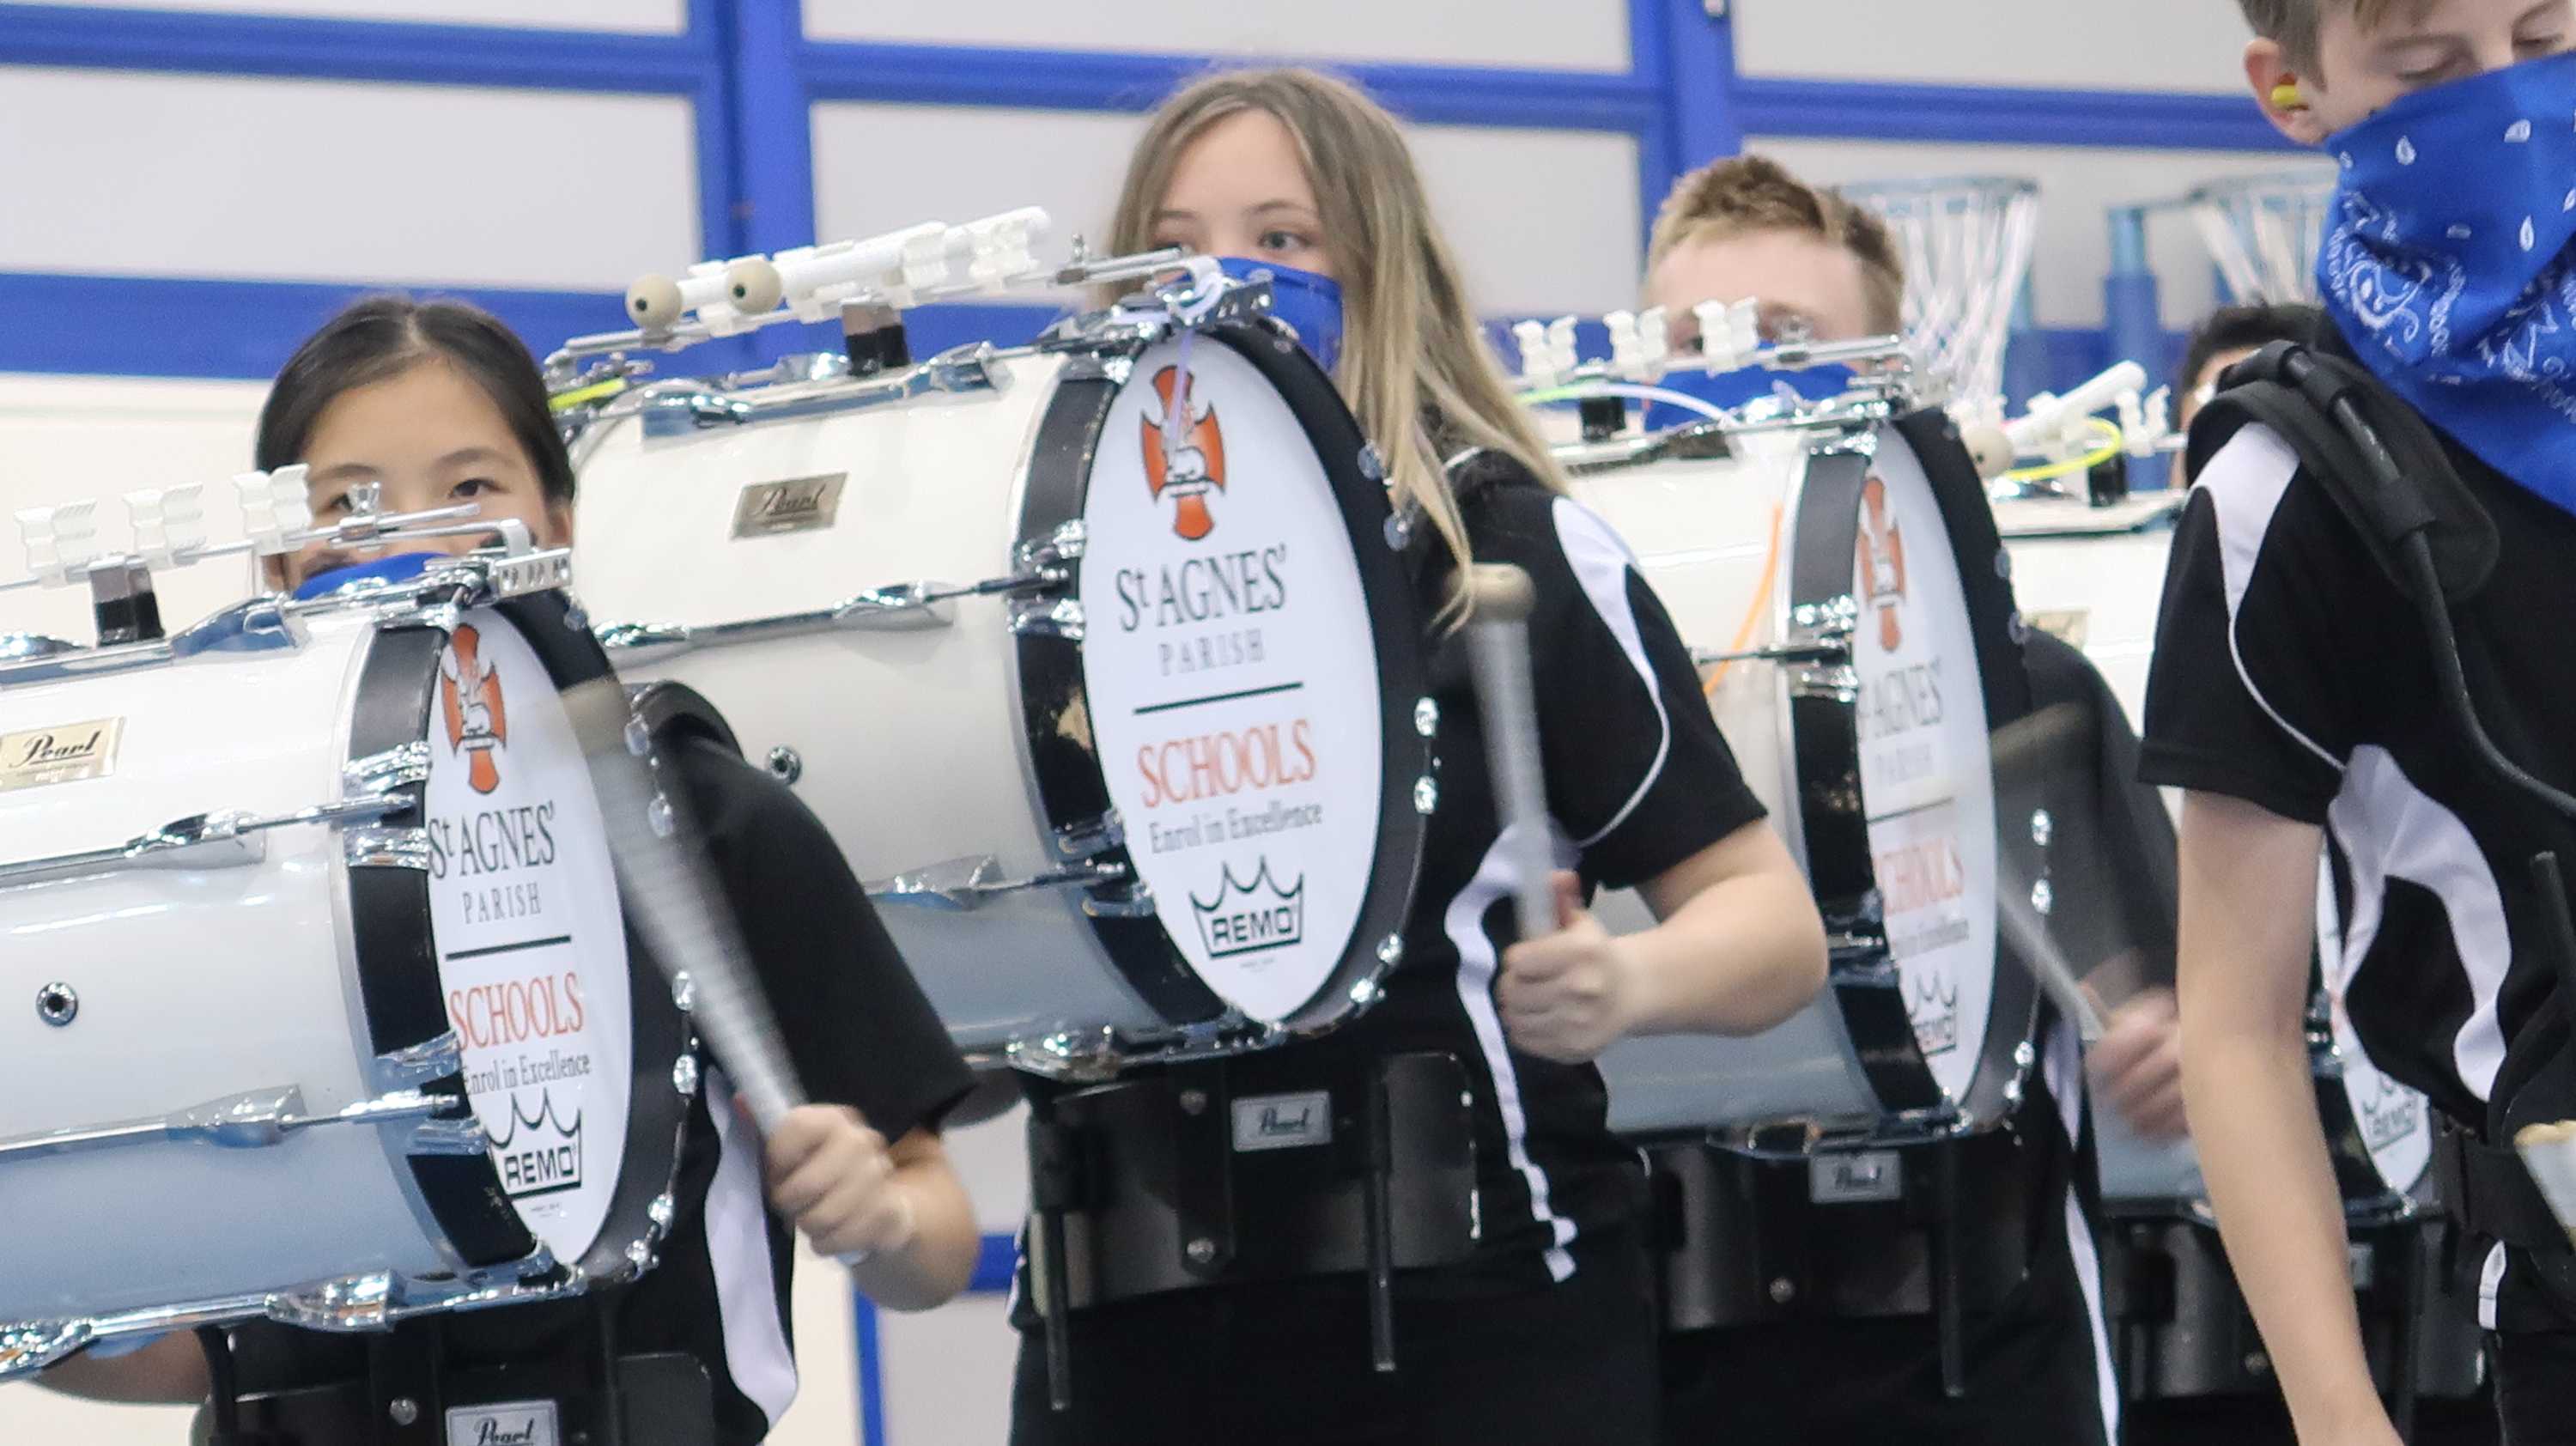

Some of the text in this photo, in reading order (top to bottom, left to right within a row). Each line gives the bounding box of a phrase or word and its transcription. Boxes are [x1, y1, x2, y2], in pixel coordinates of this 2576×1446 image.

[1155, 543, 1287, 628] AGNES'
[1158, 628, 1266, 676] PARISH
[8, 728, 102, 769] Pearl
[1137, 719, 1317, 809] SCHOOLS
[459, 799, 556, 877] AGNES'
[1148, 799, 1324, 854] Enrol in Excellence
[461, 882, 542, 925] PARISH
[1211, 906, 1294, 947] REMO
[449, 970, 584, 1053] SCHOOLS
[501, 1059, 518, 1089] in
[518, 1048, 591, 1085] Excellence
[504, 1145, 575, 1188] REMO
